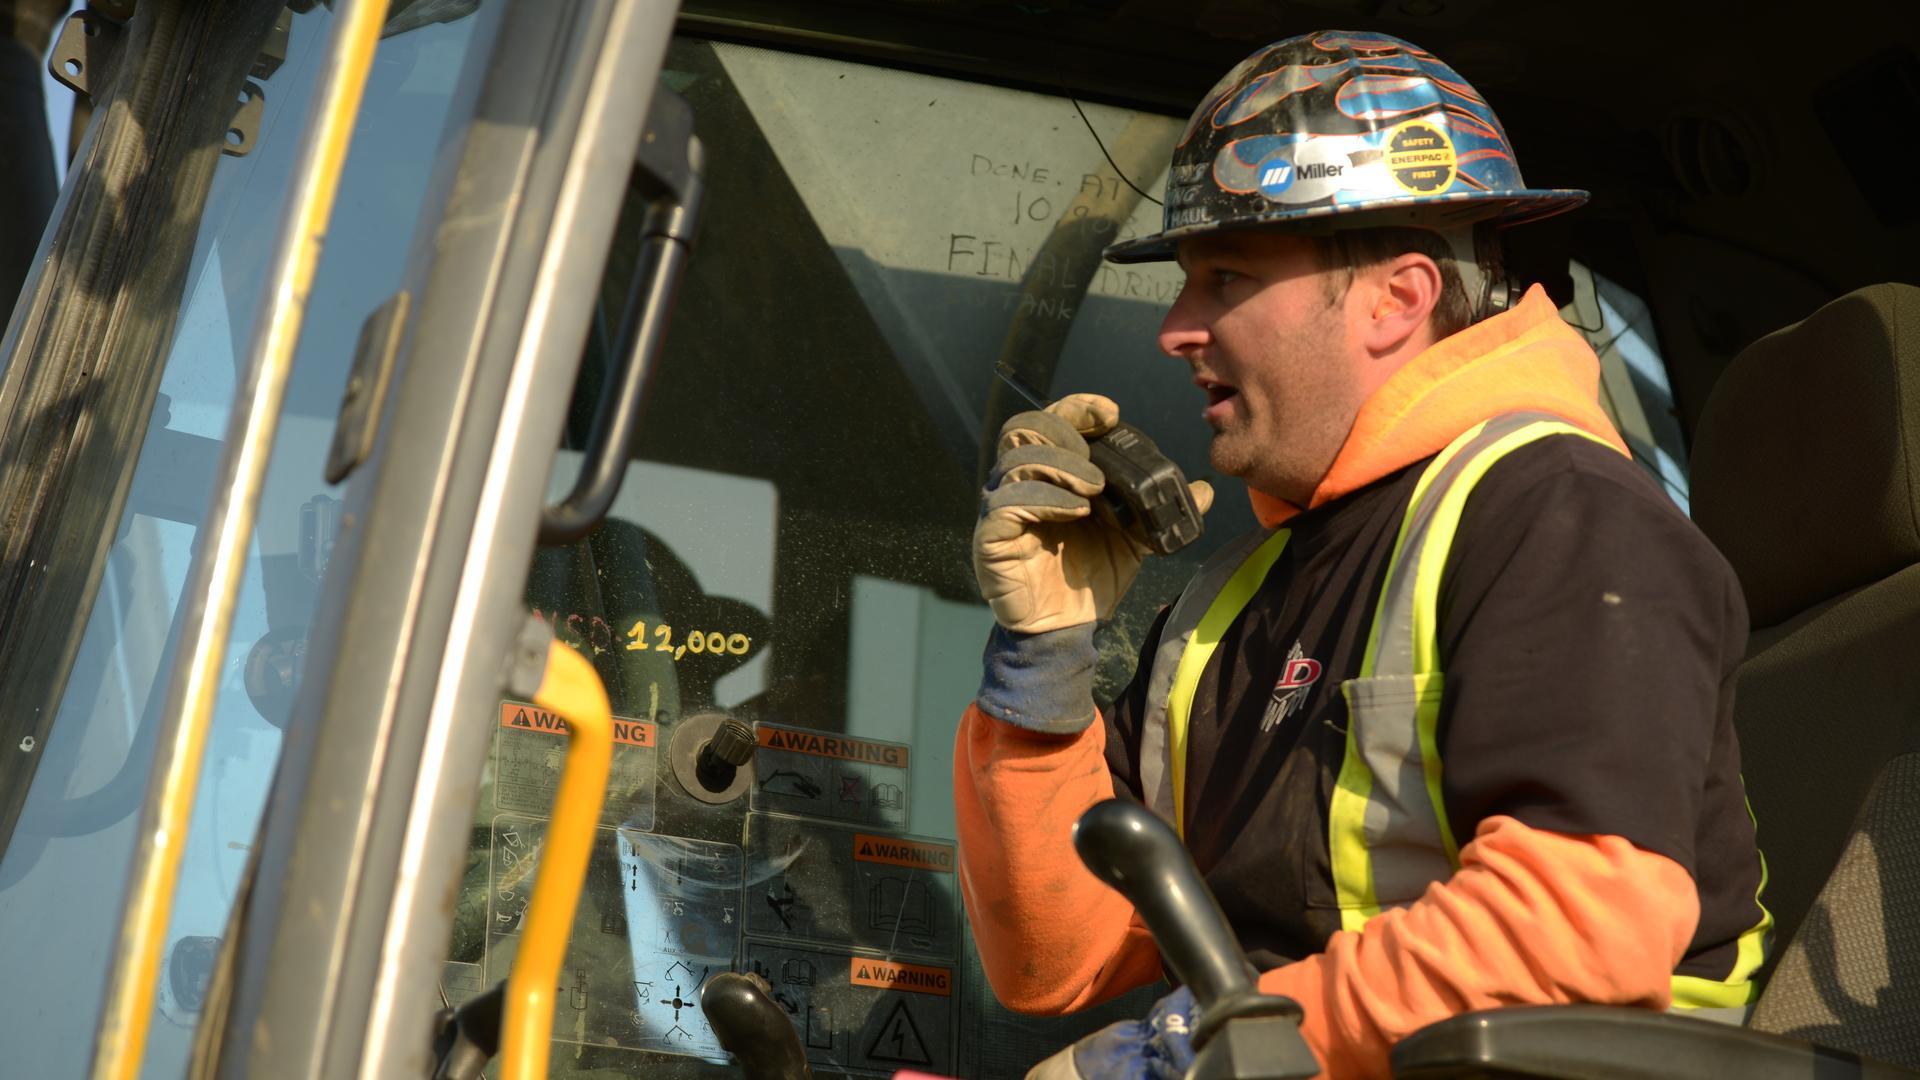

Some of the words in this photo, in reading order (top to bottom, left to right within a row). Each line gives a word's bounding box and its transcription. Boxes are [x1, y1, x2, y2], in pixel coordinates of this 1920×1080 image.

[1402, 137, 1434, 147] SAFETY
[1391, 153, 1442, 164] ENERPAC
[1296, 162, 1345, 181] Miller
[1412, 169, 1437, 179] FIRST
[1080, 173, 1123, 201] AT
[1171, 206, 1214, 228] HAUL
[947, 232, 1077, 289] FINAL
[626, 619, 751, 661] 12,000
[533, 710, 647, 743] WANG
[785, 731, 899, 765] WARNING
[875, 842, 951, 867] WARNING
[873, 966, 947, 989] WARNING
